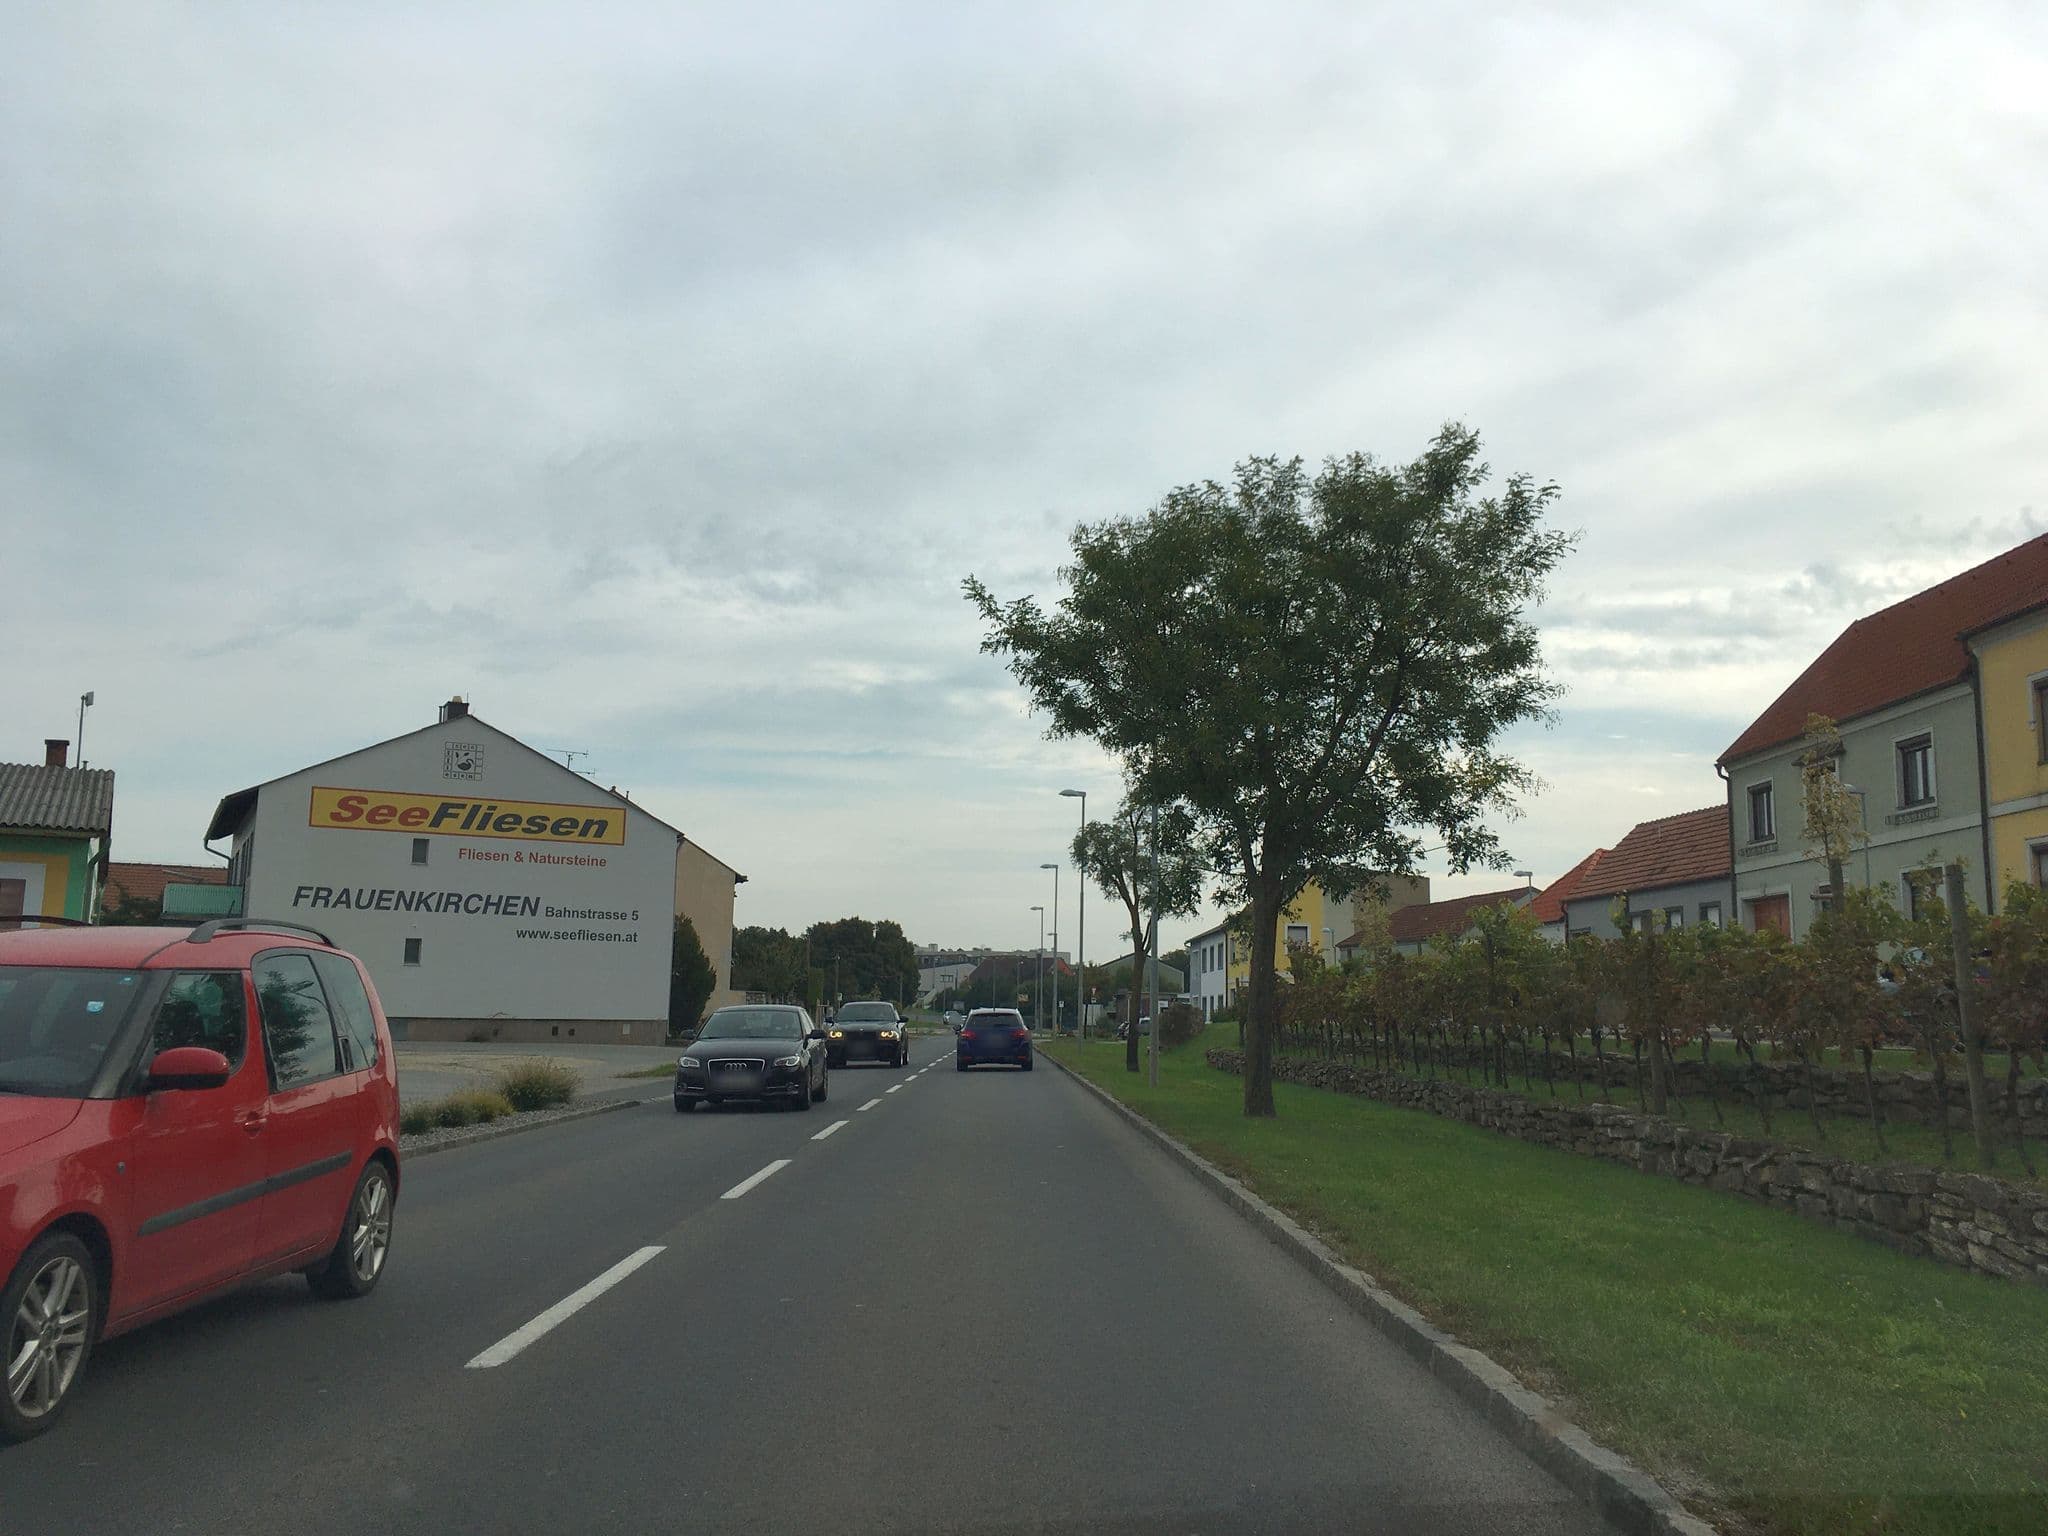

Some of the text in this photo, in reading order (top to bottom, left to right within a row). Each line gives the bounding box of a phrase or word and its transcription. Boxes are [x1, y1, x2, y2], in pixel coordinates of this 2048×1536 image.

[329, 795, 609, 838] SeeFliesen
[458, 848, 607, 867] Fliesen & Natursteine
[292, 886, 639, 921] FRAUENKIRCHEN Bahnstrasse 5
[516, 929, 638, 943] www.seefliesen.at
